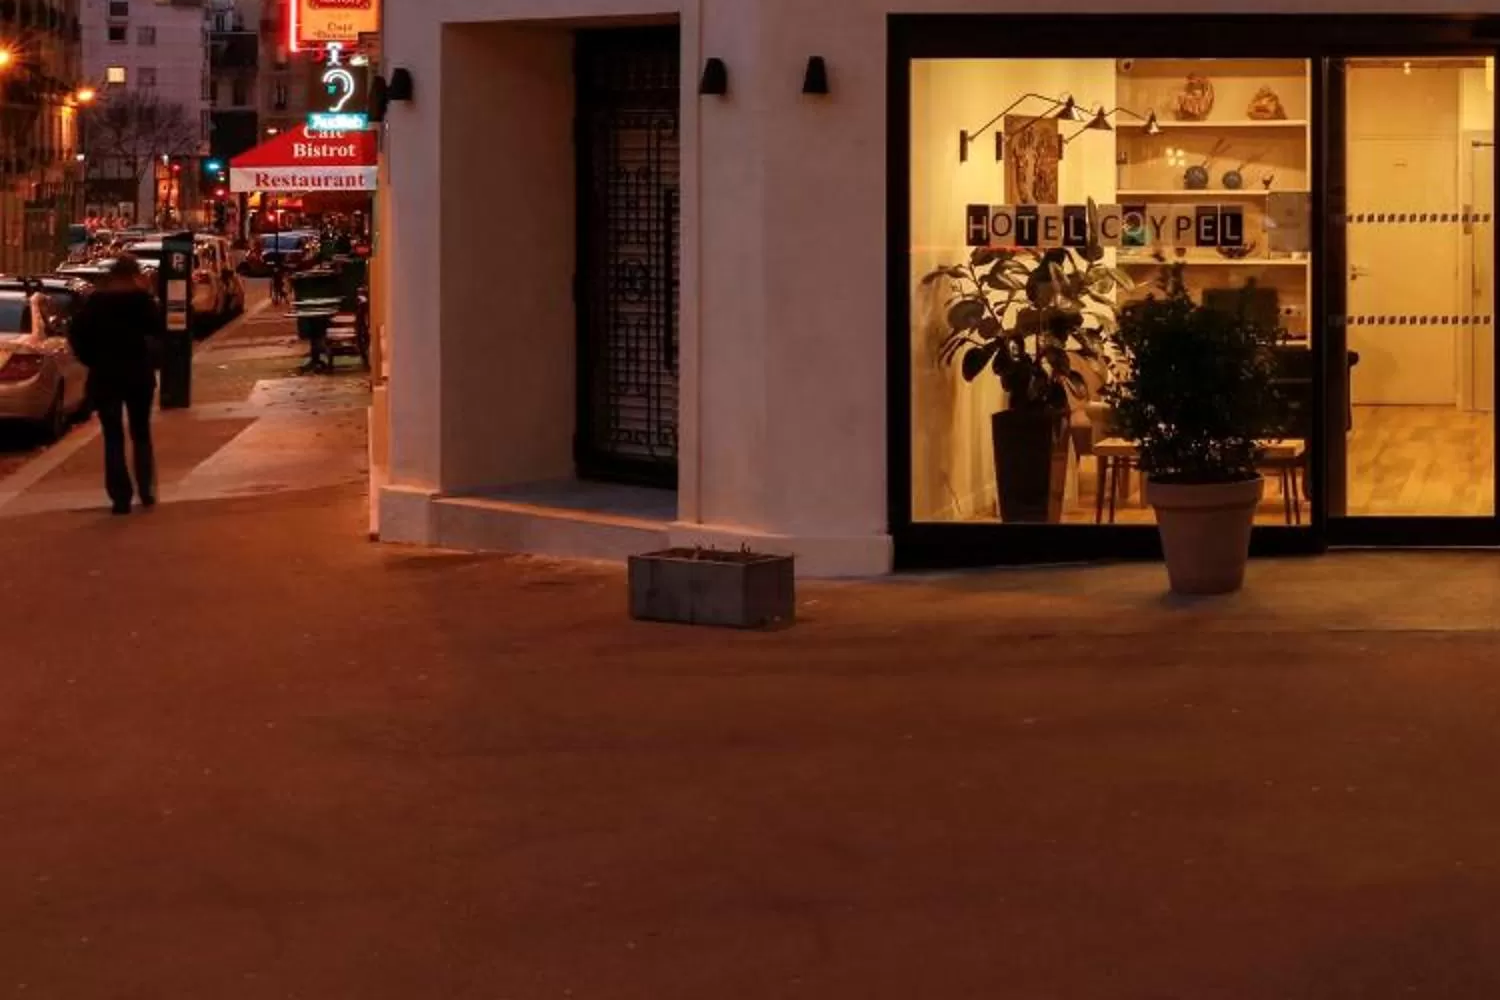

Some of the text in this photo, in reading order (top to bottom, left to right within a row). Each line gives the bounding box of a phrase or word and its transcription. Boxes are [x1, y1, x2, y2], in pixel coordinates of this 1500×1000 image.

[293, 142, 357, 159] Bistrot
[254, 172, 366, 188] Restaurant
[968, 211, 1241, 241] HOTEL COYPEL
